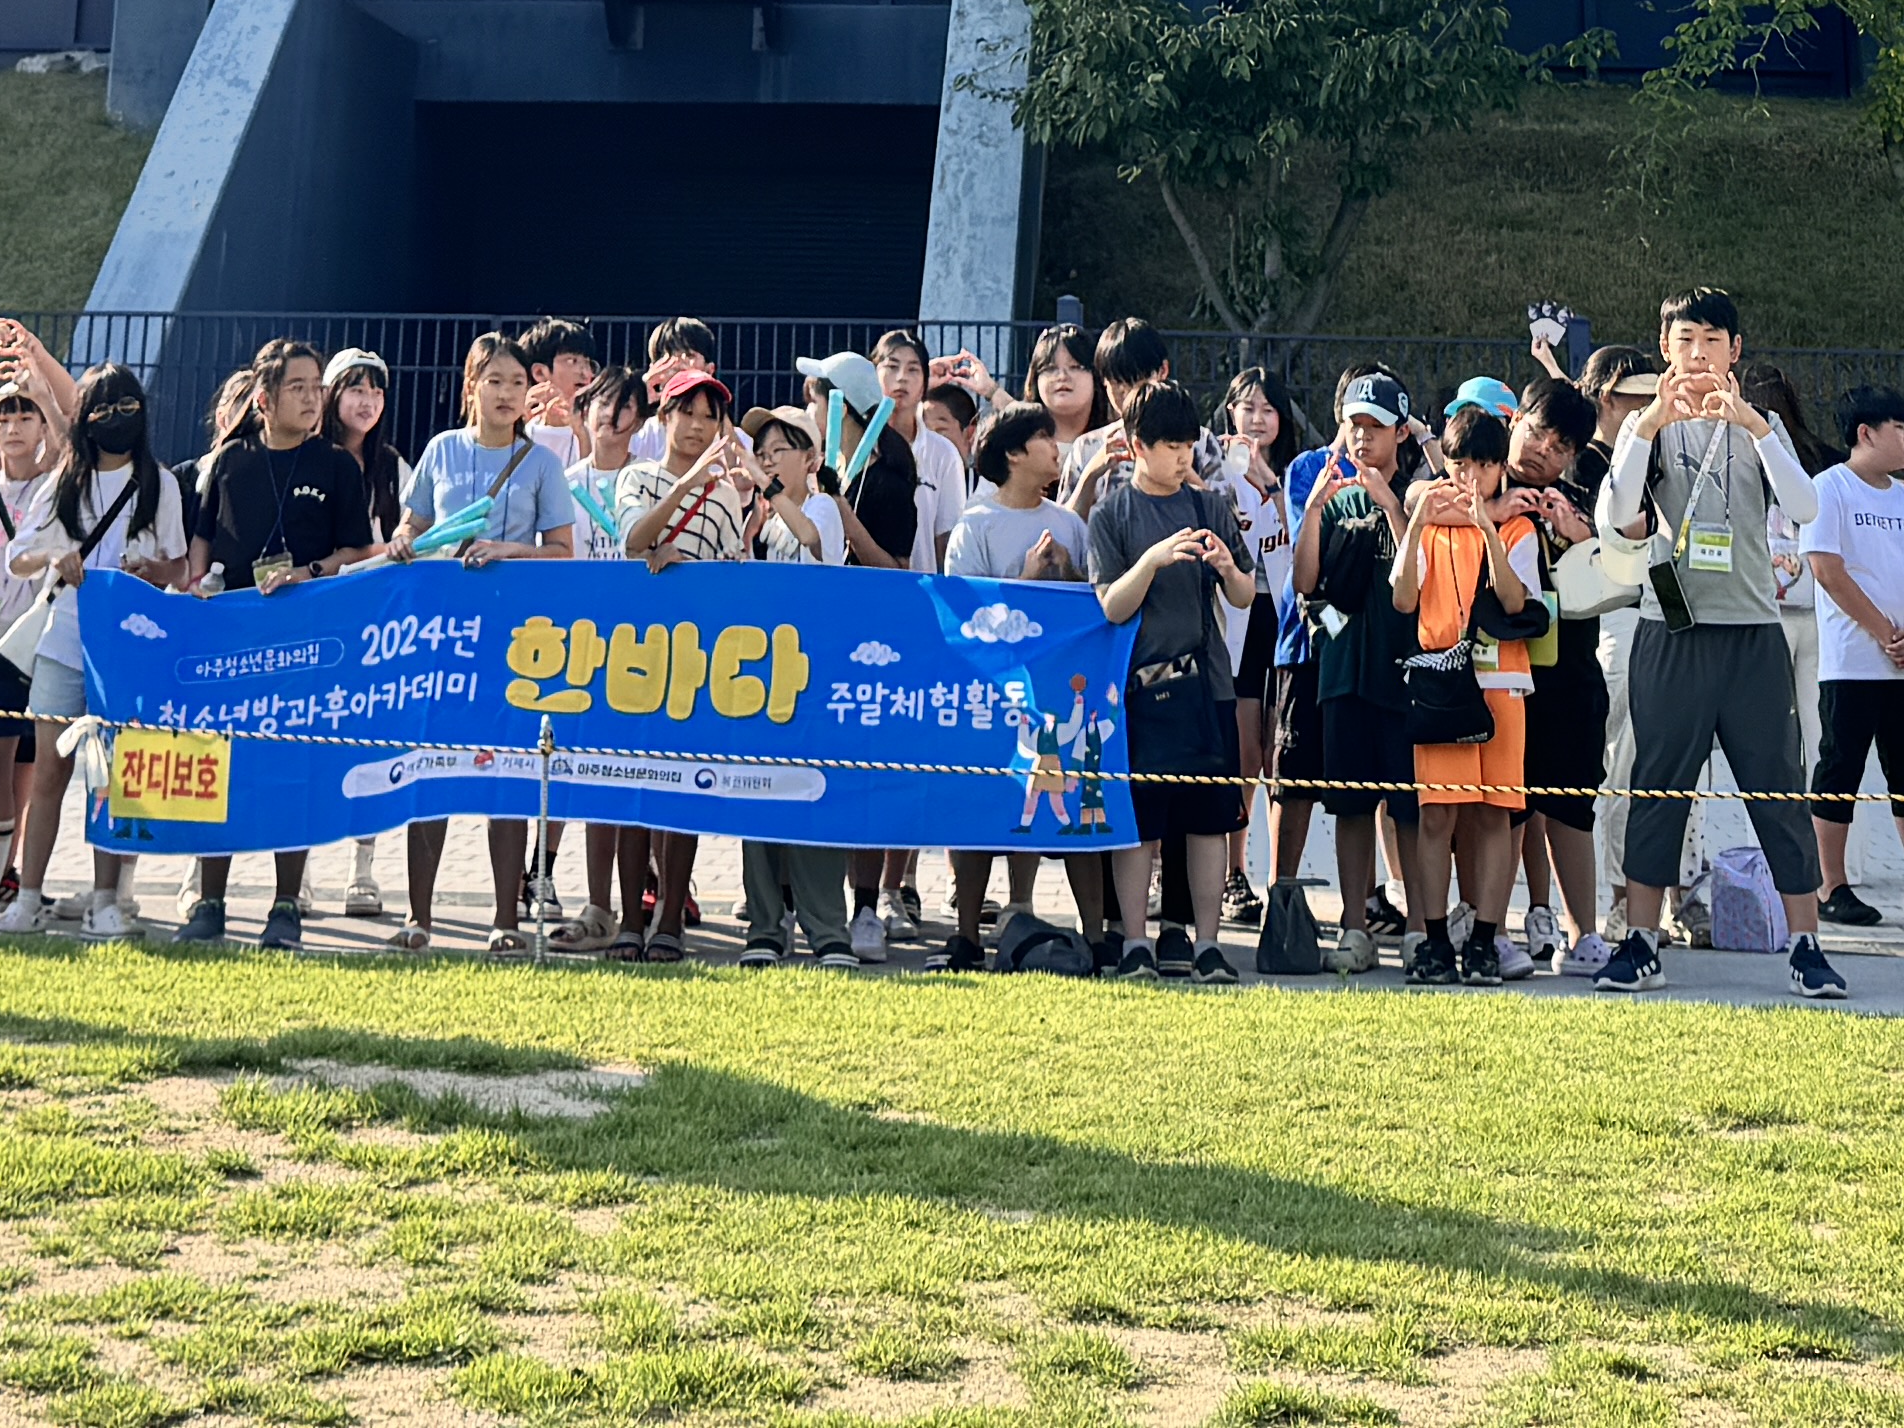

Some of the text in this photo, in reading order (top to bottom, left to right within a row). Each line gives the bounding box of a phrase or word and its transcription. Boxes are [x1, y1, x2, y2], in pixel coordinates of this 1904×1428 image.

[195, 643, 320, 679] 아주청소년문화의집
[361, 614, 482, 667] 2024년
[505, 616, 810, 724] 한바다
[826, 678, 1029, 730] 주말체험활동
[122, 748, 219, 800] 잔디보호
